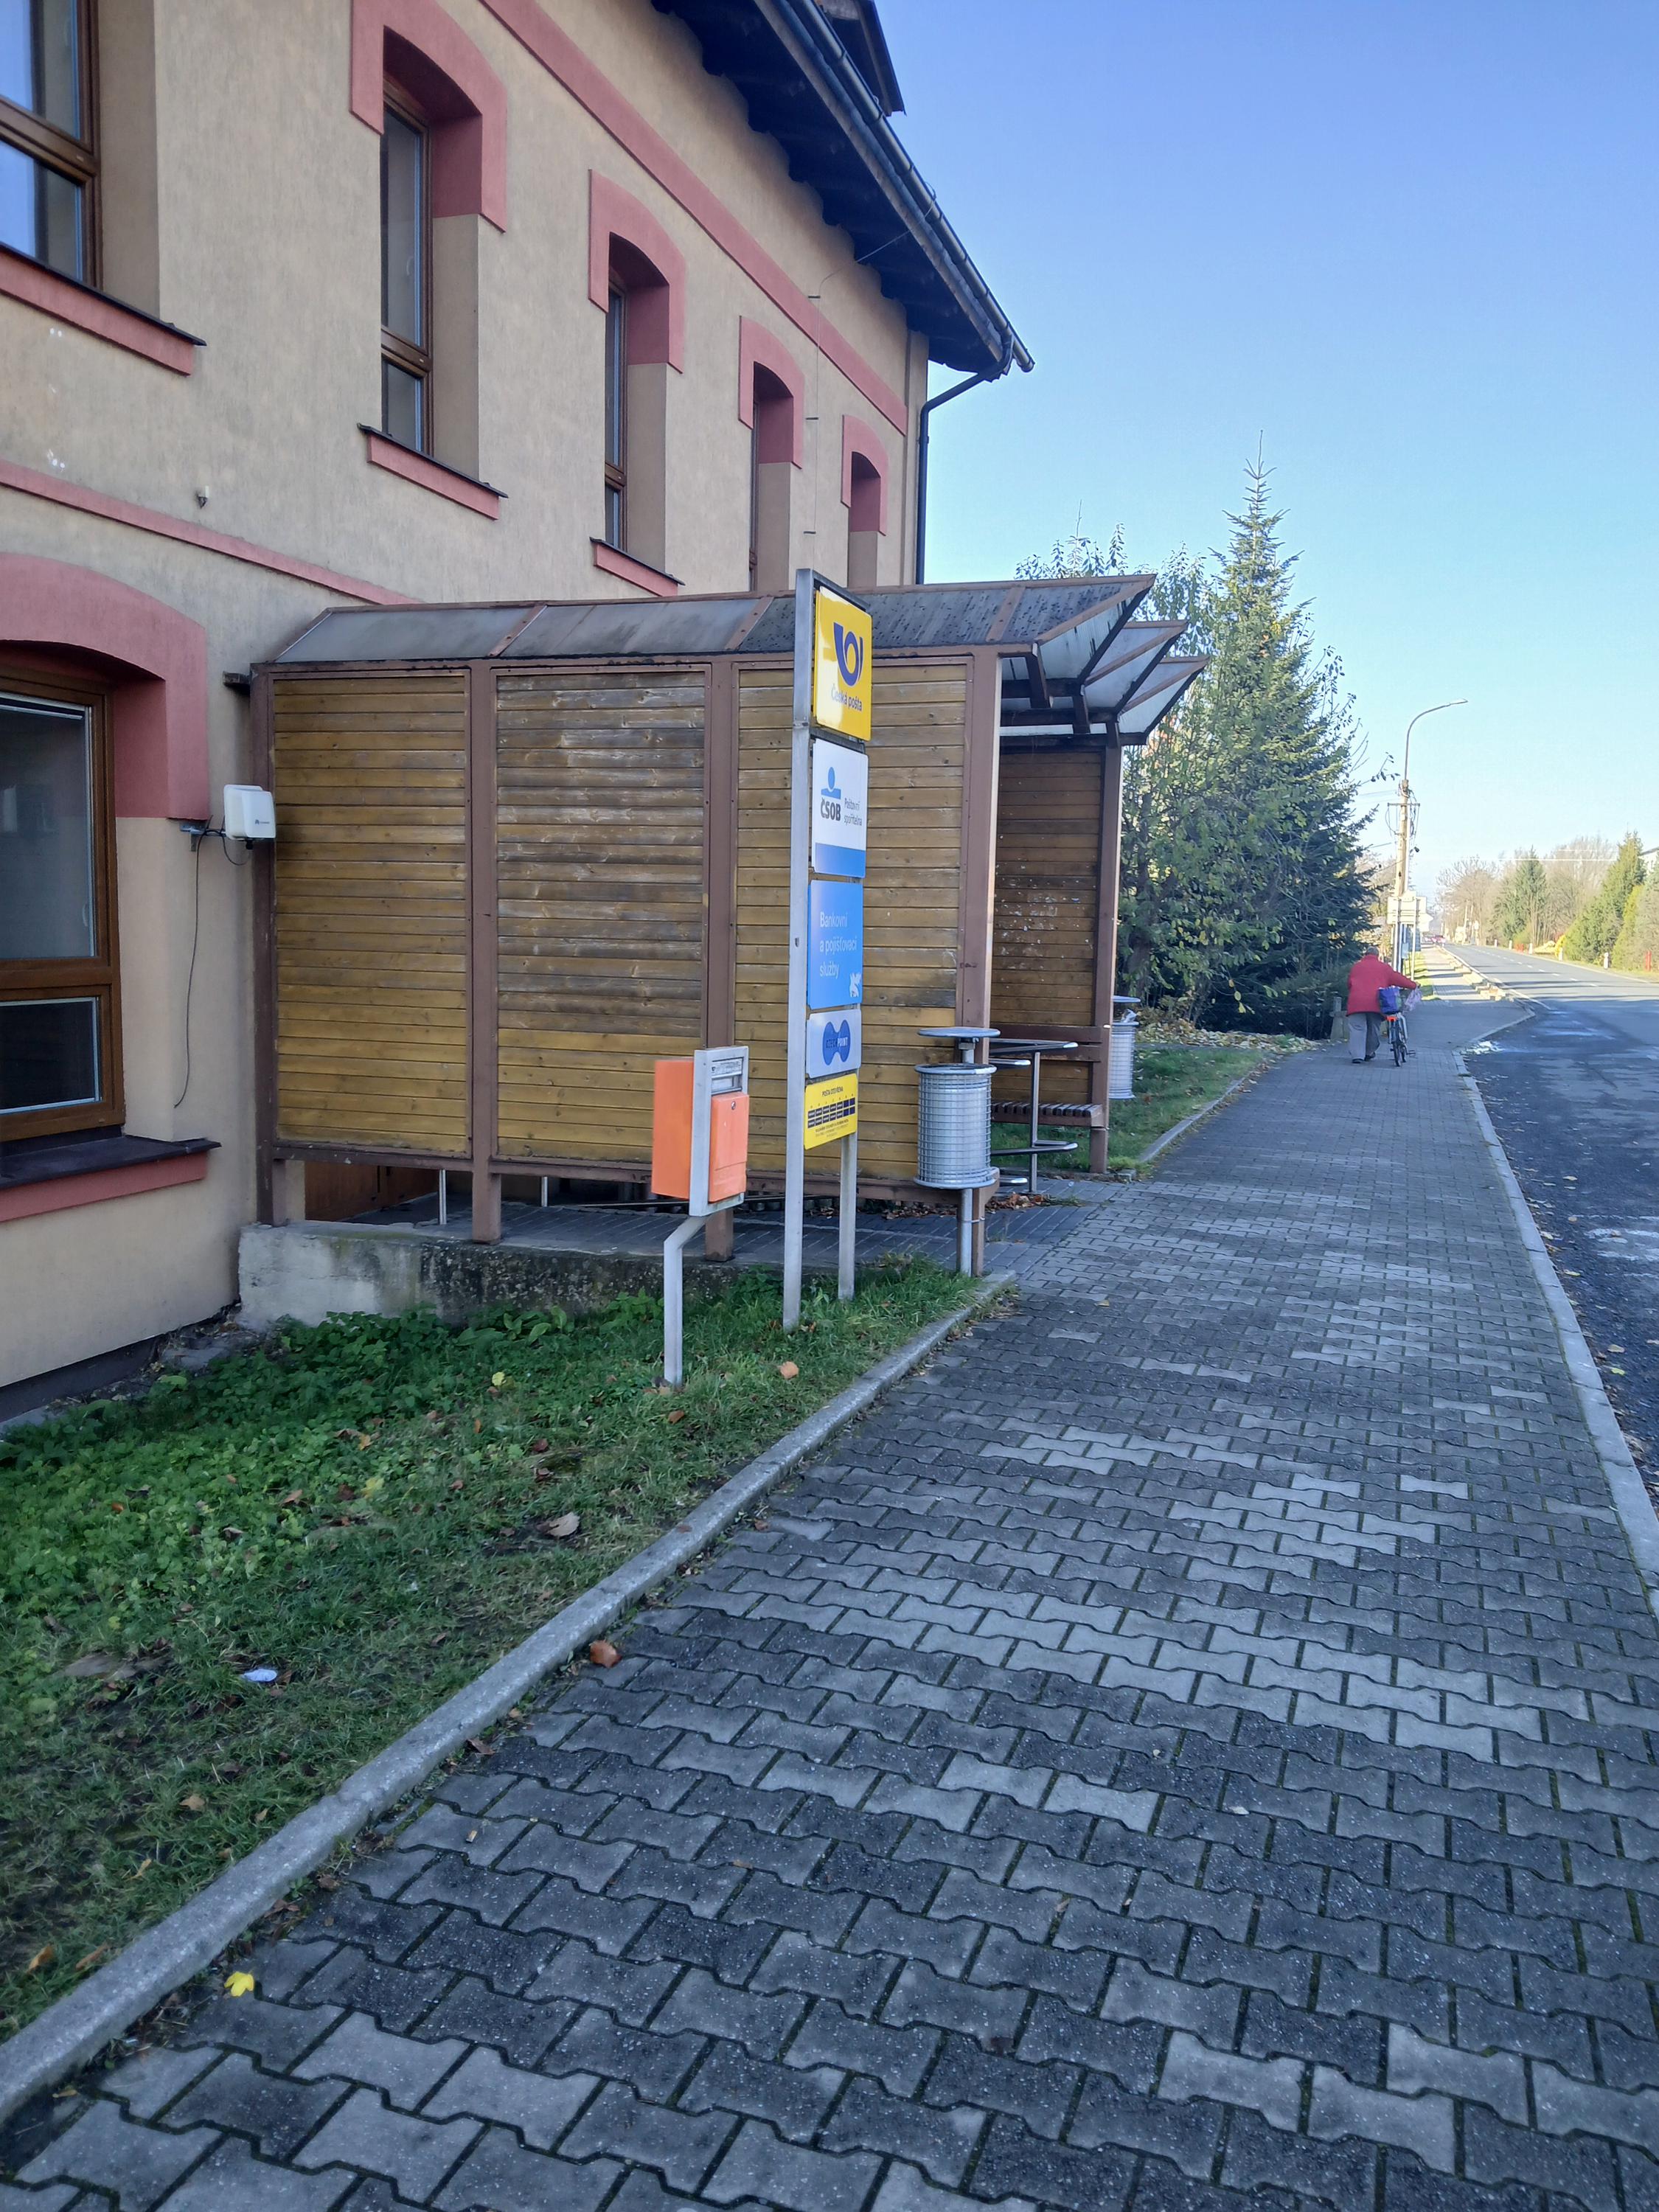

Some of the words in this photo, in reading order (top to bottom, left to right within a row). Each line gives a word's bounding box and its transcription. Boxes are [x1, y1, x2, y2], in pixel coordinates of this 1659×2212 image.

[848, 695, 862, 712] pošta
[820, 797, 841, 821] ČSOB
[820, 911, 848, 928] Bankovní
[820, 940, 824, 953] a
[820, 961, 839, 980] služby
